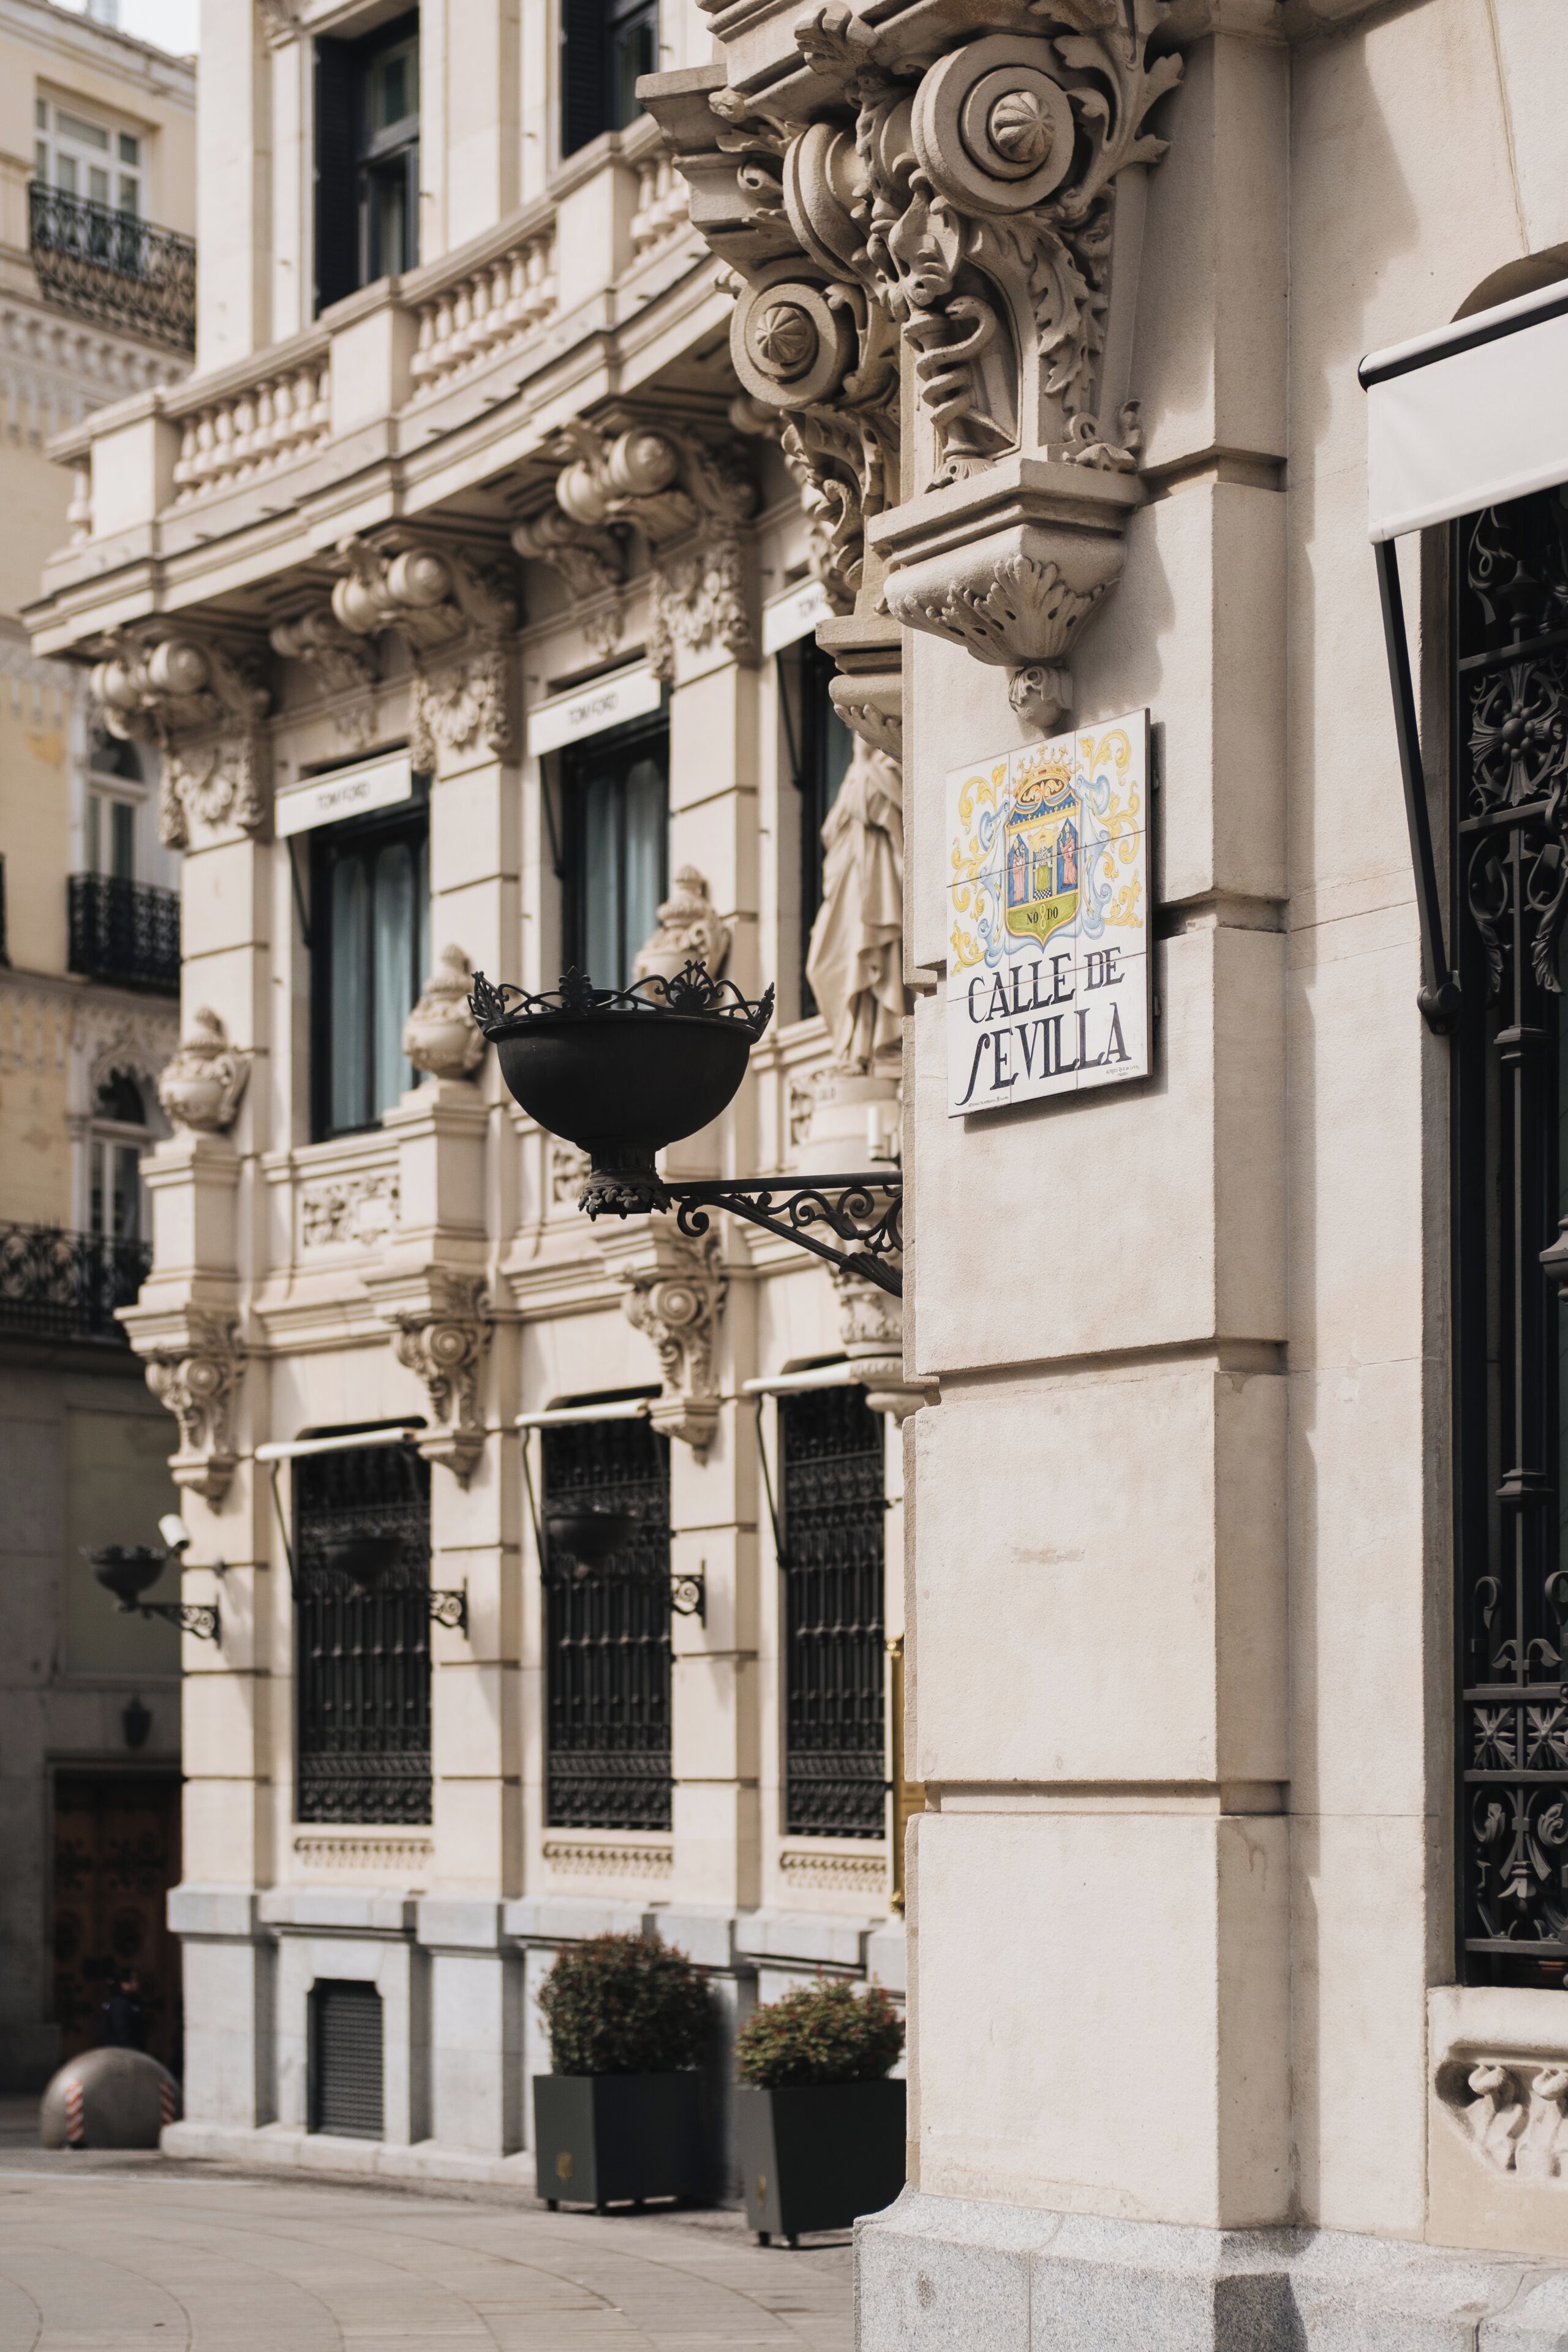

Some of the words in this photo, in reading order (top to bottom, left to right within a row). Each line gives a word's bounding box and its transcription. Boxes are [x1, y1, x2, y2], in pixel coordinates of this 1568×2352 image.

[1027, 911, 1038, 924] NO
[1047, 907, 1058, 920] DO
[968, 952, 1076, 1023] CALLE
[1084, 946, 1125, 991] DE
[955, 1002, 1131, 1105] SEVILLA
